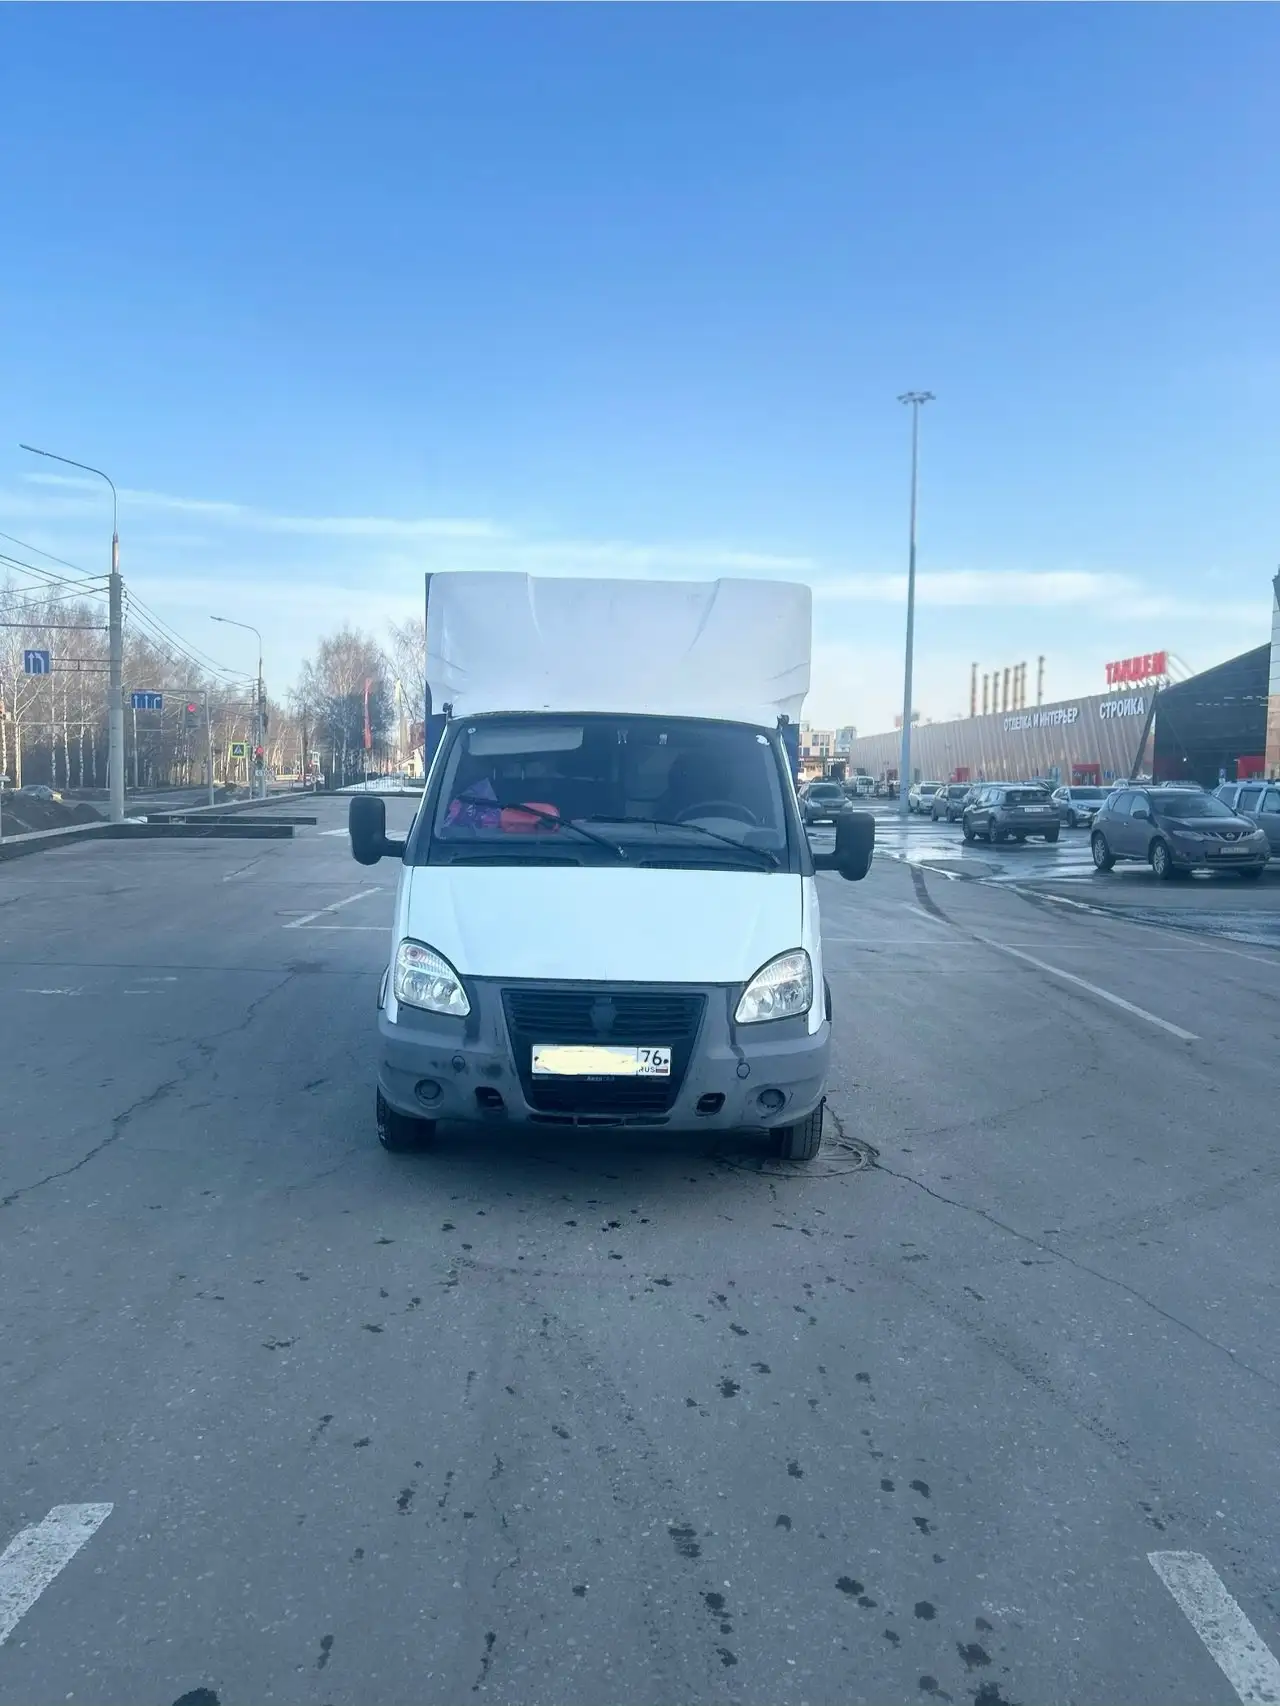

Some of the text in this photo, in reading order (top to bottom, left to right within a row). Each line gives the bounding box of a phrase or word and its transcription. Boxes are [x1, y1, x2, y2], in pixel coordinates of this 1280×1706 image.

[1033, 713, 1039, 727] И
[1040, 707, 1078, 727] ИНТЕРЬЕР
[641, 1050, 661, 1065] 76
